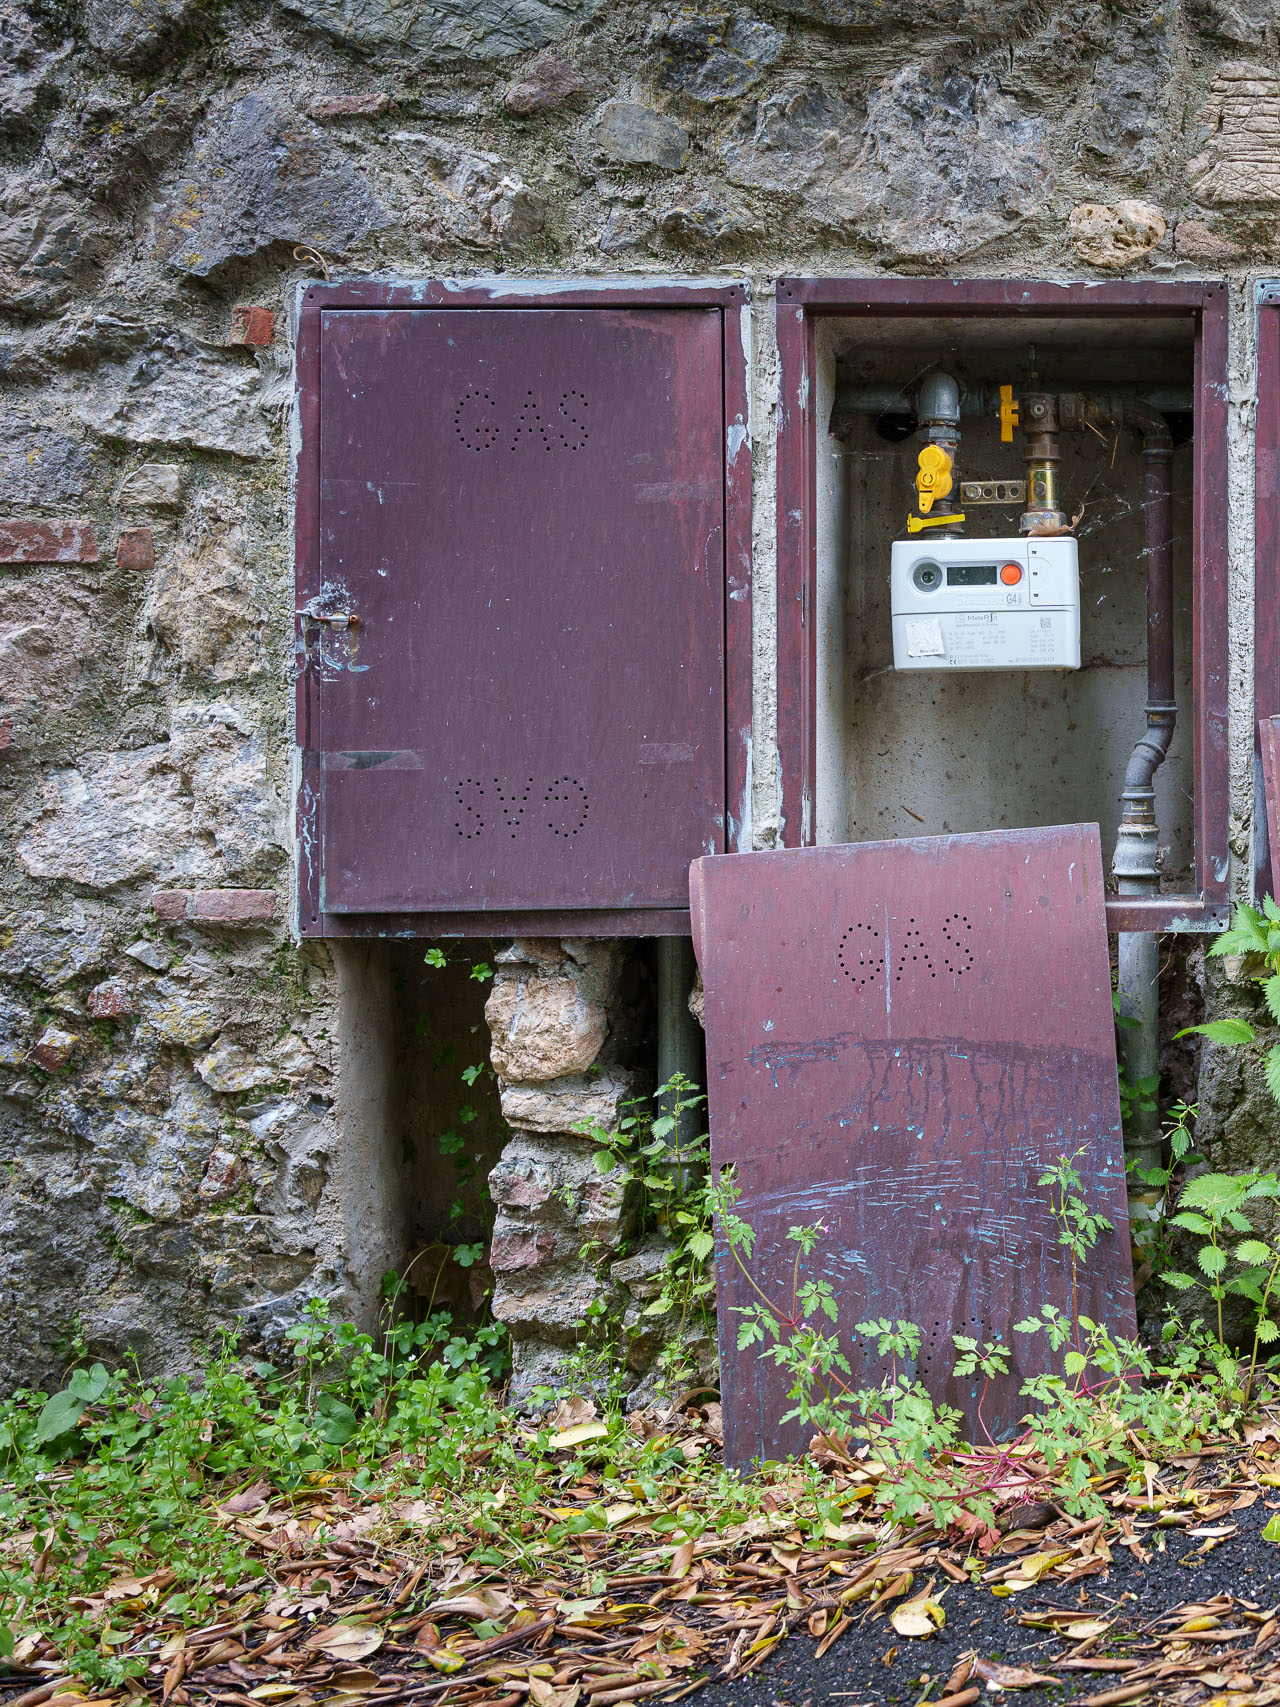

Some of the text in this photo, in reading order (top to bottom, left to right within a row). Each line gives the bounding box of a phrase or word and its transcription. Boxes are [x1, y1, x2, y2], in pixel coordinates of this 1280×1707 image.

[454, 390, 589, 452] GAS
[455, 777, 589, 839] GAS
[837, 914, 974, 984] GAS
